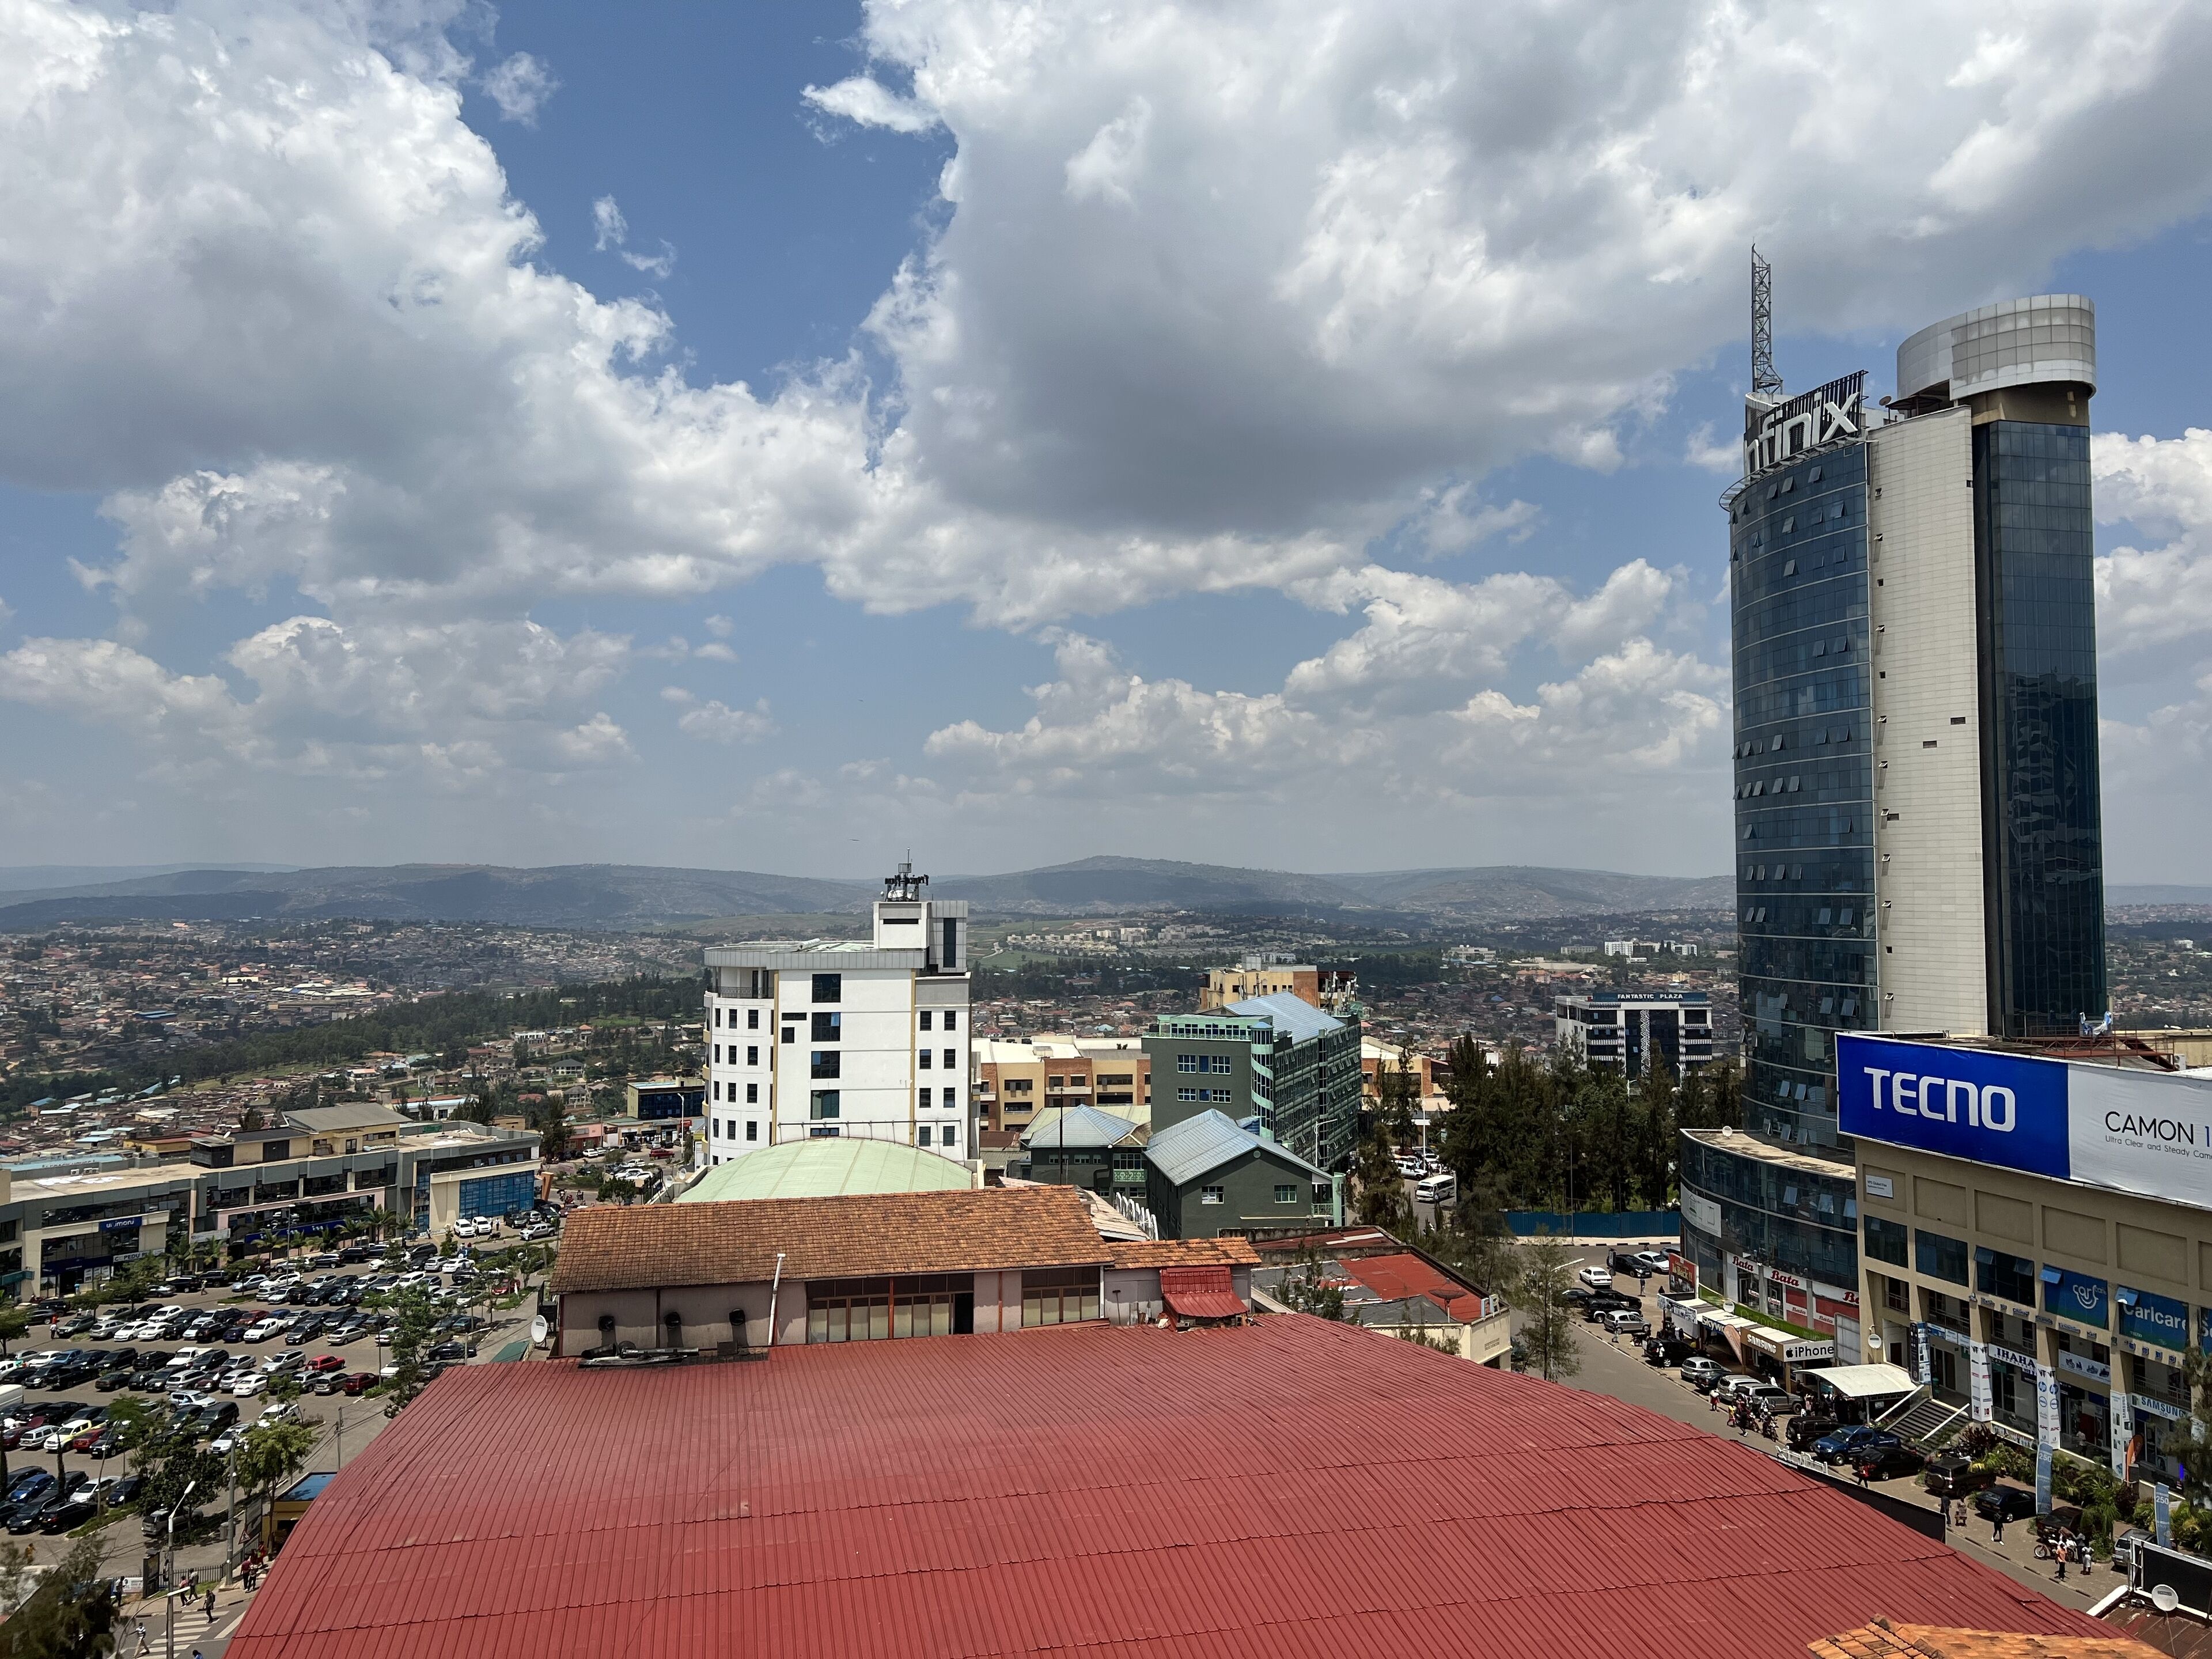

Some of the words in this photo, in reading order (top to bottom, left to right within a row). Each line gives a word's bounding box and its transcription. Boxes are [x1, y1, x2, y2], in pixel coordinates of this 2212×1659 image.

[1864, 1067, 2016, 1132] TECNO
[2105, 1111, 2194, 1145] CAMON
[2105, 1135, 2122, 1144] Ultra
[2125, 1138, 2143, 1147] Clear
[2147, 1143, 2161, 1151] and
[2164, 1145, 2190, 1157] Steady
[1732, 1256, 1754, 1272] Bata
[1770, 1270, 1800, 1287] Bata
[1792, 1306, 1806, 1315] Bata
[1819, 1315, 1833, 1324] Bata
[1747, 1334, 1777, 1354] SAMSUNG
[1795, 1346, 1834, 1357] iPhone
[1997, 1348, 2036, 1368] IHAHA
[2039, 1381, 2047, 1392] hp
[2141, 1396, 2184, 1416] SAMSUNG
[2039, 1453, 2052, 1463] 250
[2156, 1495, 2169, 1505] 250
